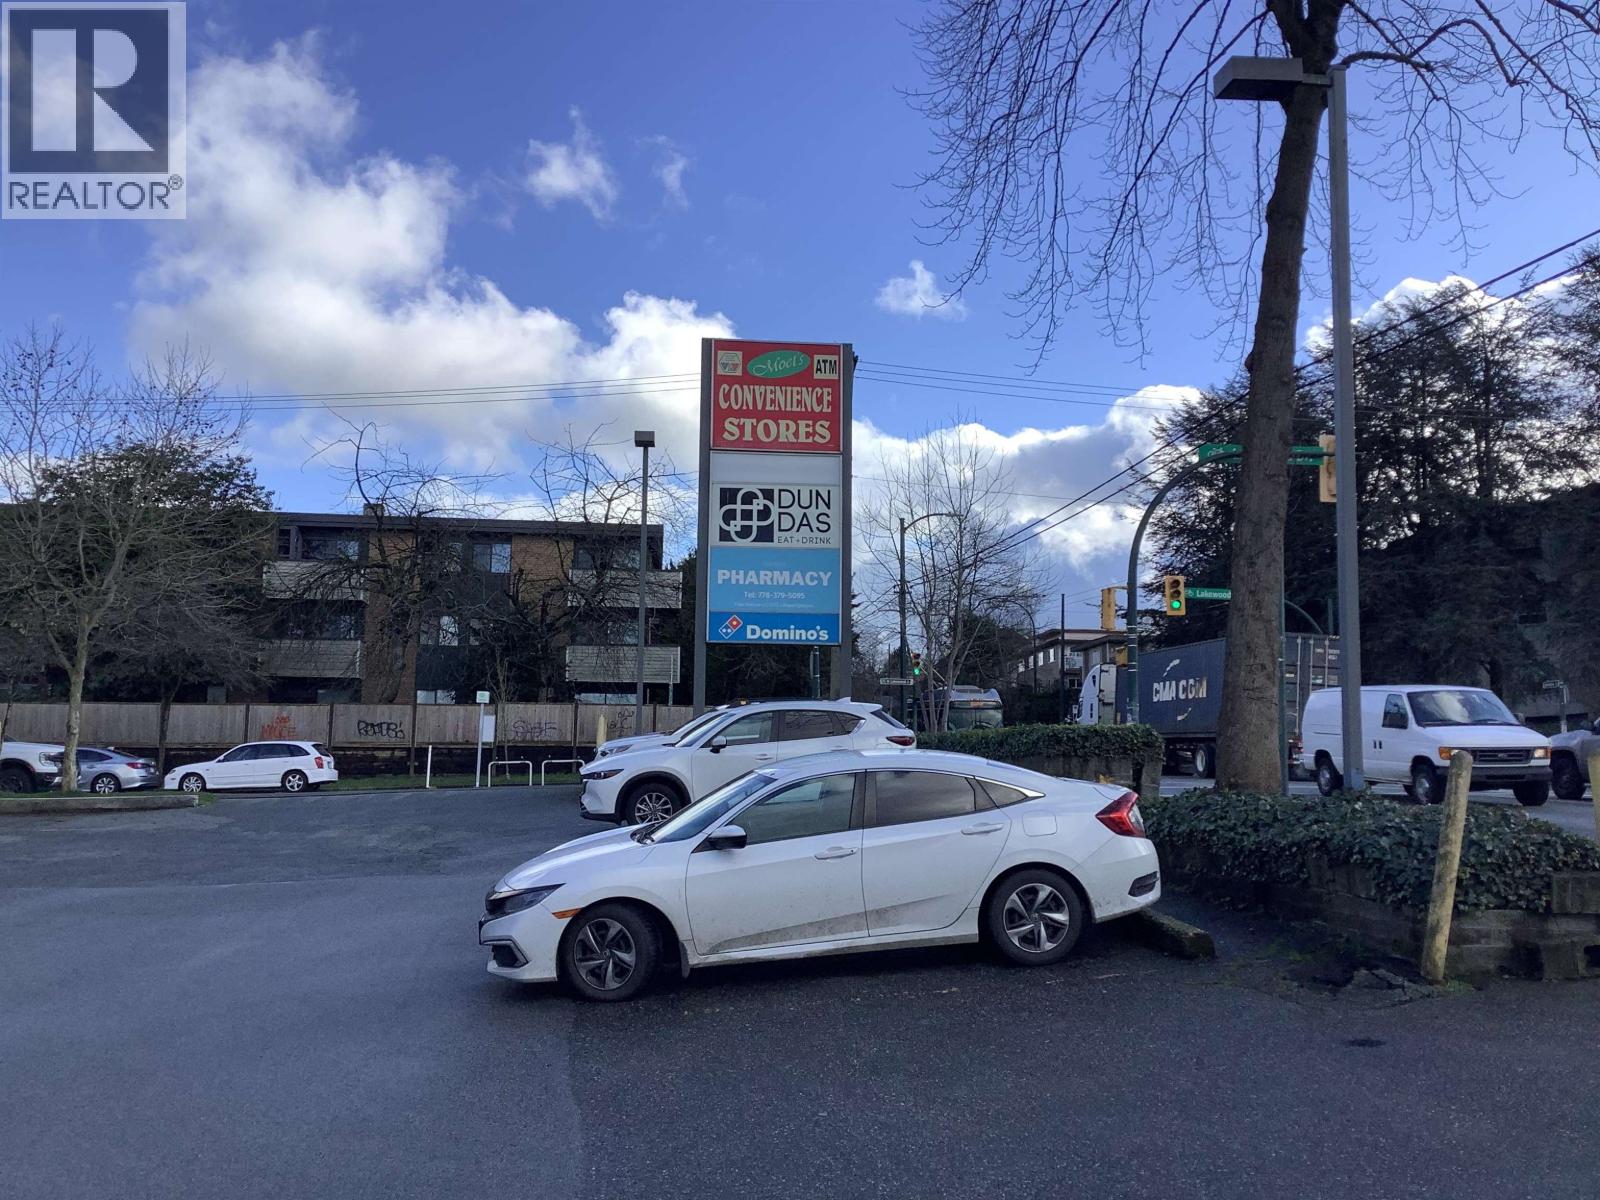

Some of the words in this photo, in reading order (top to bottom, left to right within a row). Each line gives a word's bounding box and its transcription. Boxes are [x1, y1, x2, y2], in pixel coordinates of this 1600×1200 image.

[815, 359, 837, 374] ATM
[718, 383, 832, 413] CONVENIENCE
[722, 417, 831, 444] STORES
[778, 488, 831, 510] DUN
[778, 512, 831, 533] DAS
[777, 536, 794, 544] EAT
[801, 536, 832, 545] DRINK
[717, 569, 832, 586] PHARMACY
[1196, 590, 1232, 599] Lakewood
[746, 624, 829, 641] Domino's
[1153, 681, 1176, 702] CMA
